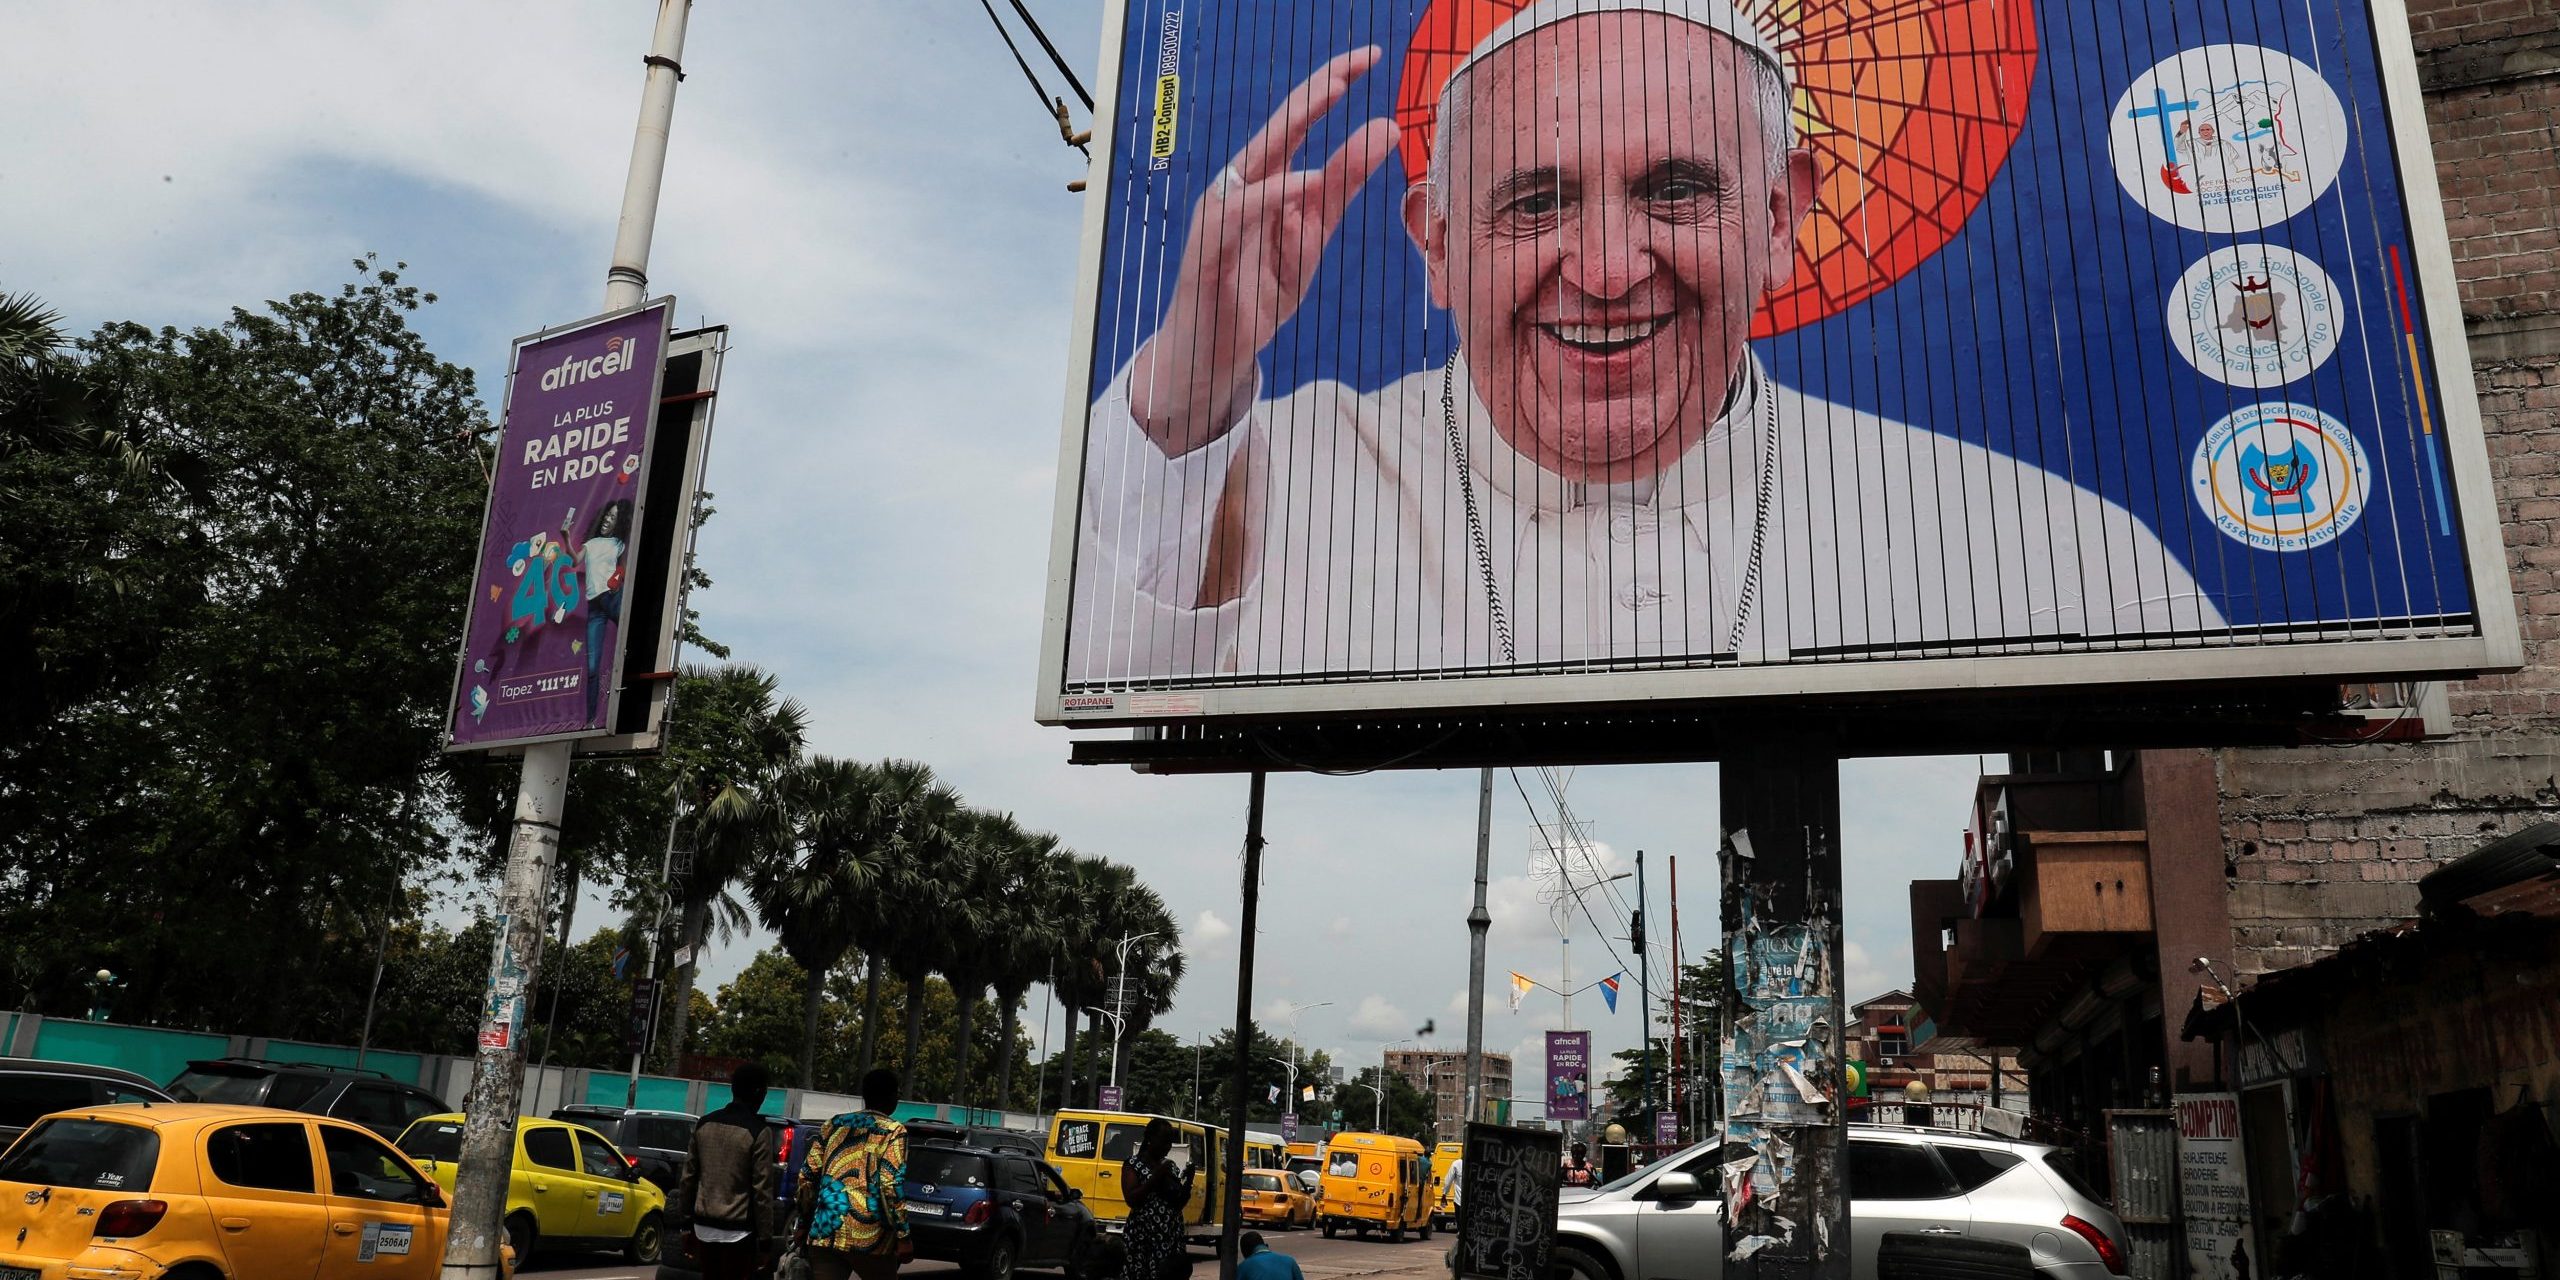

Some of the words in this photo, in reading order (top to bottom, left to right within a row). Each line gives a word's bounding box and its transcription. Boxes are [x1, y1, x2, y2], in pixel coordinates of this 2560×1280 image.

[1160, 10, 1181, 76] 0895004222
[1155, 77, 1175, 156] HB2-Concept
[1153, 156, 1168, 171] By
[2187, 259, 2248, 321] Conférence
[540, 338, 636, 391] africell
[554, 411, 572, 428] LA
[575, 401, 614, 423] PLUS
[523, 416, 629, 466] RAPIDE
[531, 468, 558, 489] EN
[562, 450, 615, 483] RDC
[2217, 513, 2295, 547] Assemblée
[2299, 504, 2358, 546] nationale
[512, 553, 580, 626] 4G
[501, 681, 533, 699] Tapez
[1064, 697, 1114, 706] ROTAPANEL
[2180, 1099, 2239, 1138] COMPTOIR
[100, 1172, 107, 1180] 5
[108, 1173, 124, 1182] Year
[1368, 1188, 1386, 1199] 207
[379, 1237, 409, 1248] 2506AP
